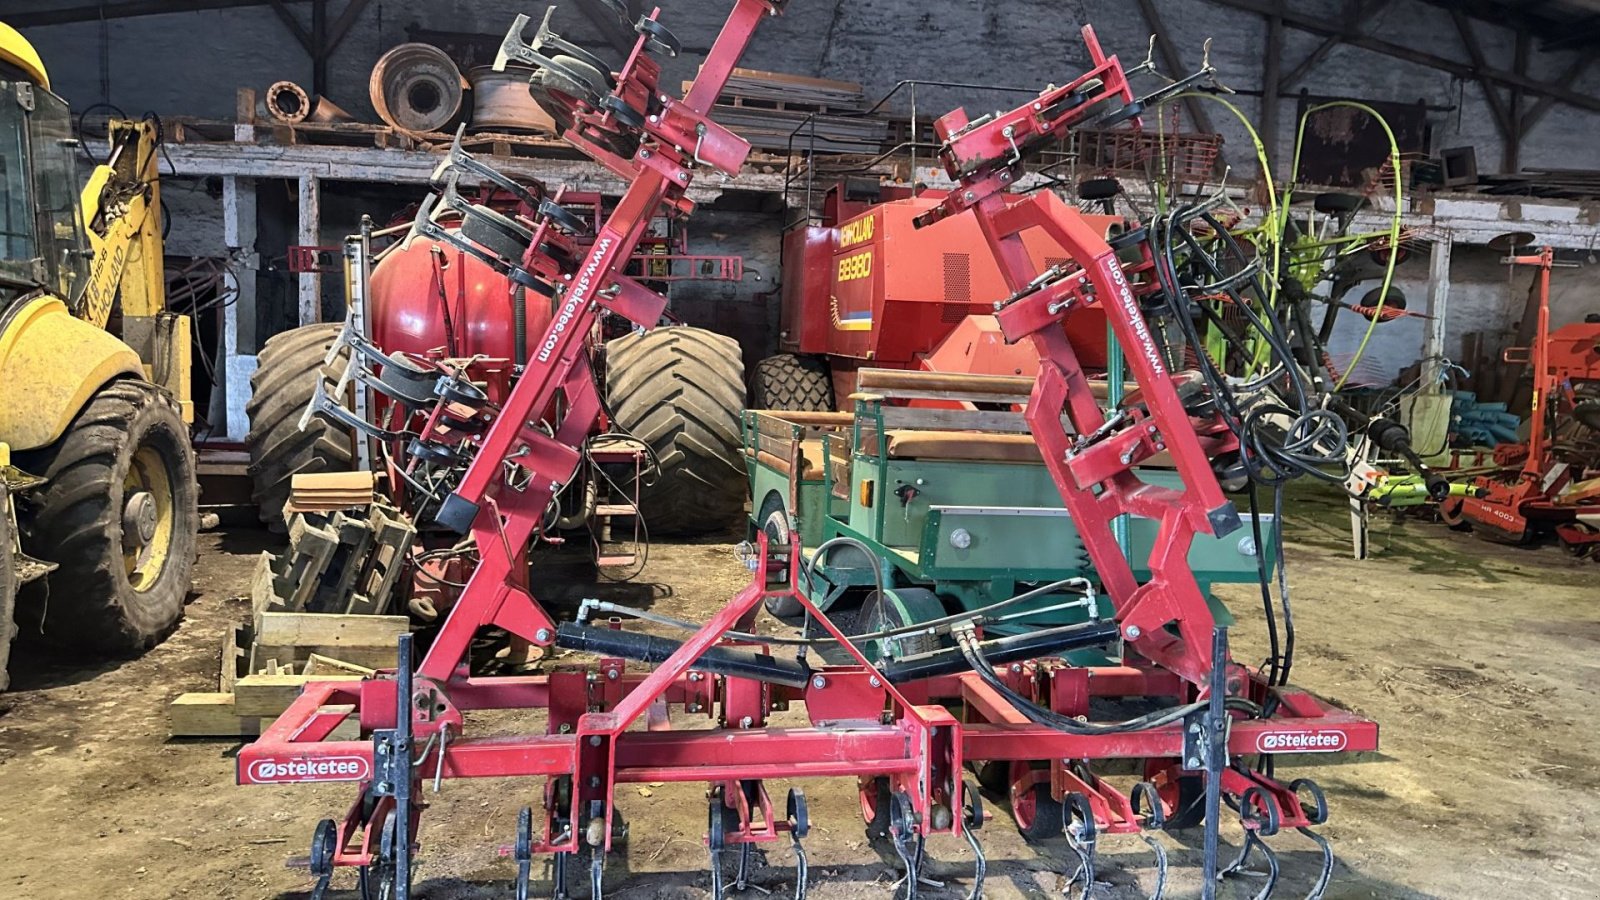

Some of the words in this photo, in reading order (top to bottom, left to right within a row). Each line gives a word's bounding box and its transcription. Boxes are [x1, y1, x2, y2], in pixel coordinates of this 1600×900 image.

[850, 214, 875, 245] HOLLAND
[838, 251, 872, 282] BB980
[538, 238, 612, 362] www.steketee.com
[1107, 258, 1163, 378] www.steketee.com
[1494, 510, 1515, 522] 4003
